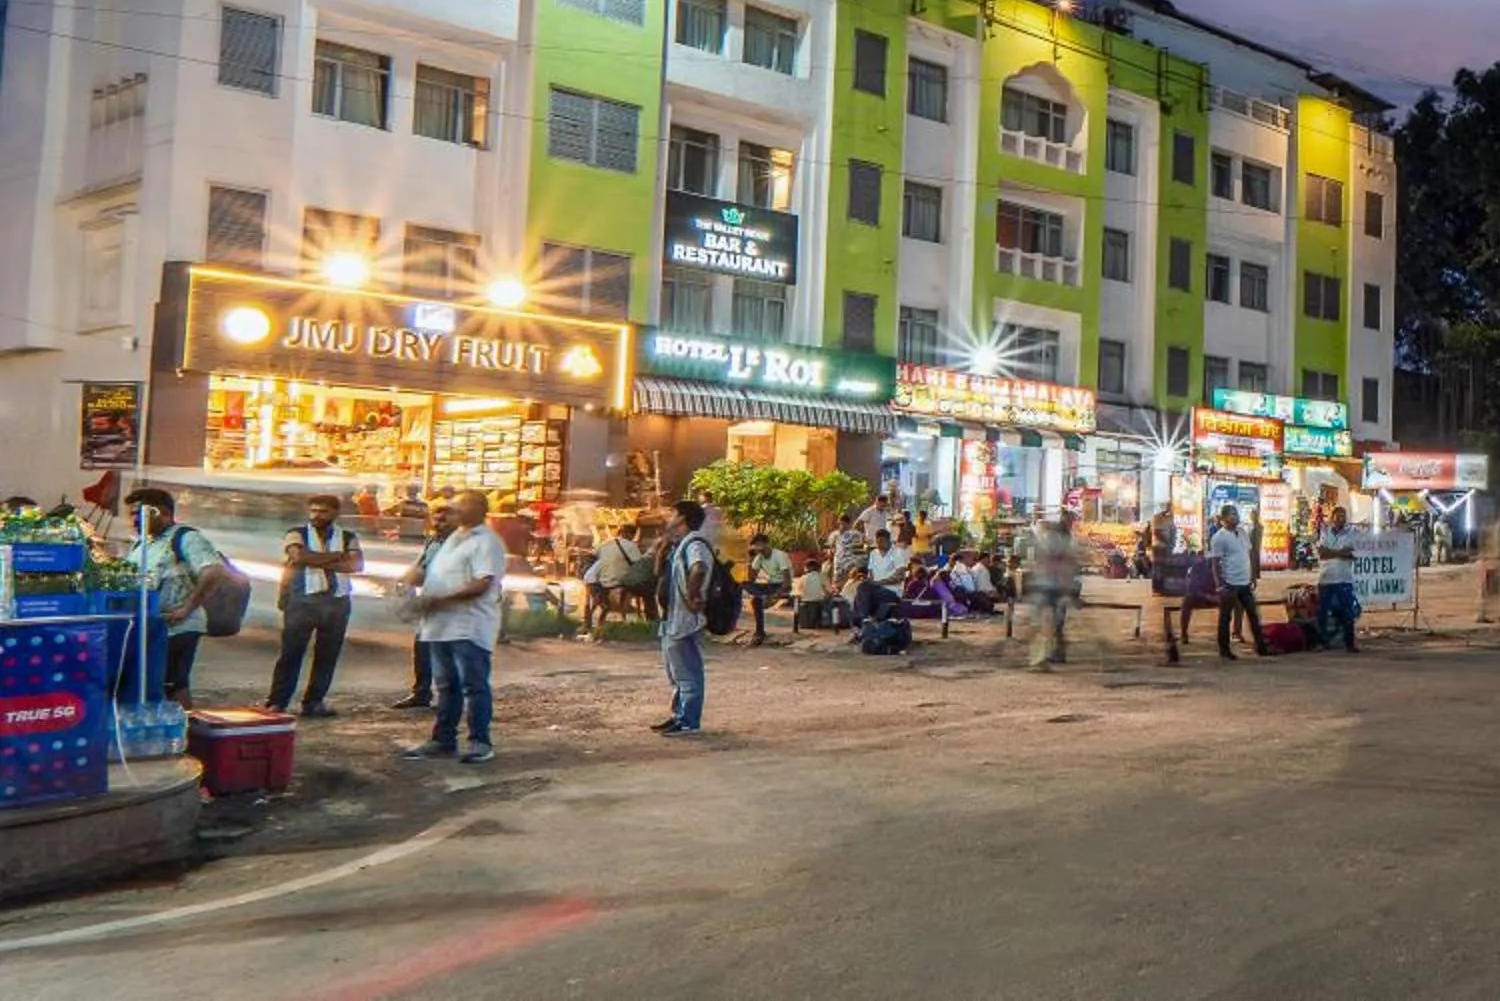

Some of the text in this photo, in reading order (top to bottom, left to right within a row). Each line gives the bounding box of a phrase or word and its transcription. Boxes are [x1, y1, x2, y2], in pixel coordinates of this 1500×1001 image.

[703, 233, 742, 254] BAR
[744, 240, 759, 256] &
[672, 243, 788, 278] RESTAURANT
[284, 315, 550, 375] JMJ DRY FRUIT
[654, 335, 728, 363] HOTEL
[1353, 556, 1397, 574] HOTEL
[6, 705, 76, 723] TRUE 5G
